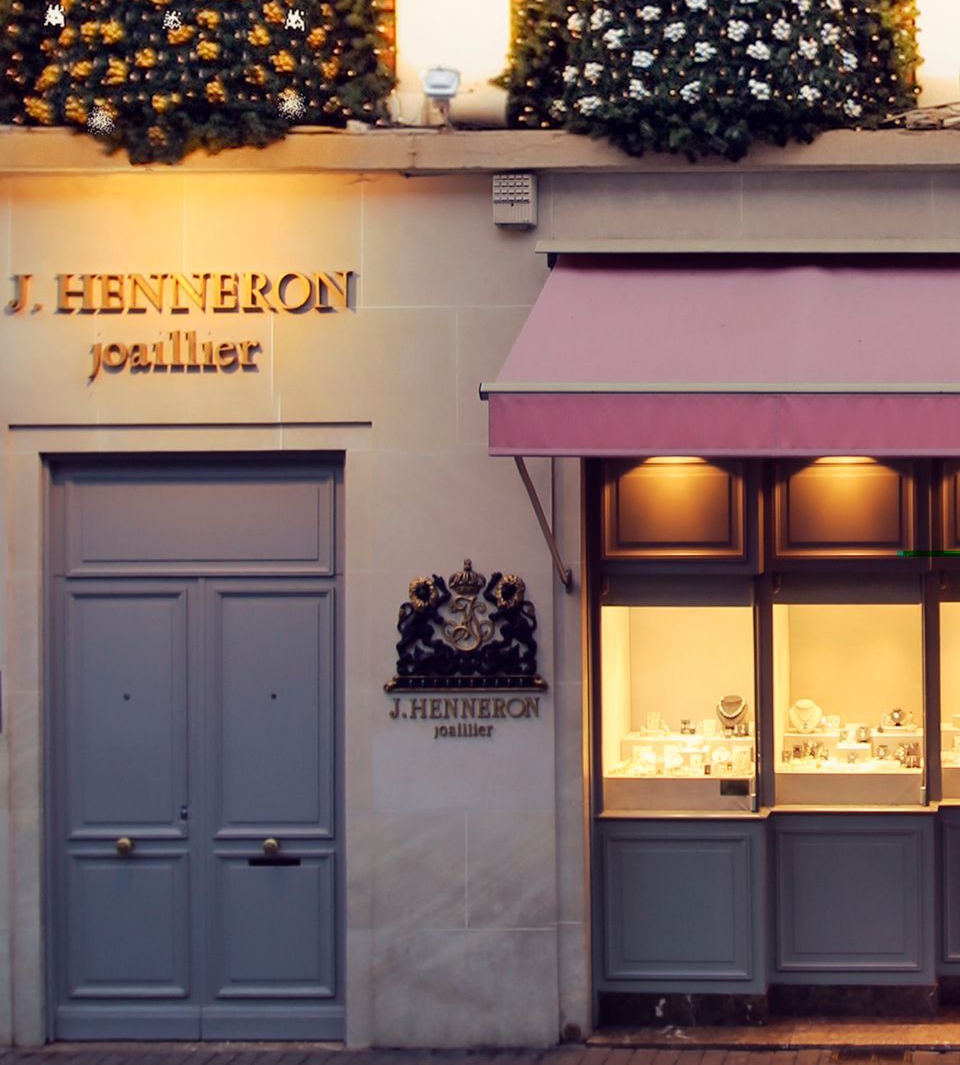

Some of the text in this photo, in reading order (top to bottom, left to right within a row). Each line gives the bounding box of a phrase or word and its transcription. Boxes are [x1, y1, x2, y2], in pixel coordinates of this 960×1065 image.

[5, 271, 355, 314] J. HENNERON
[88, 330, 260, 385] joaillier
[434, 722, 493, 738] joaillier
